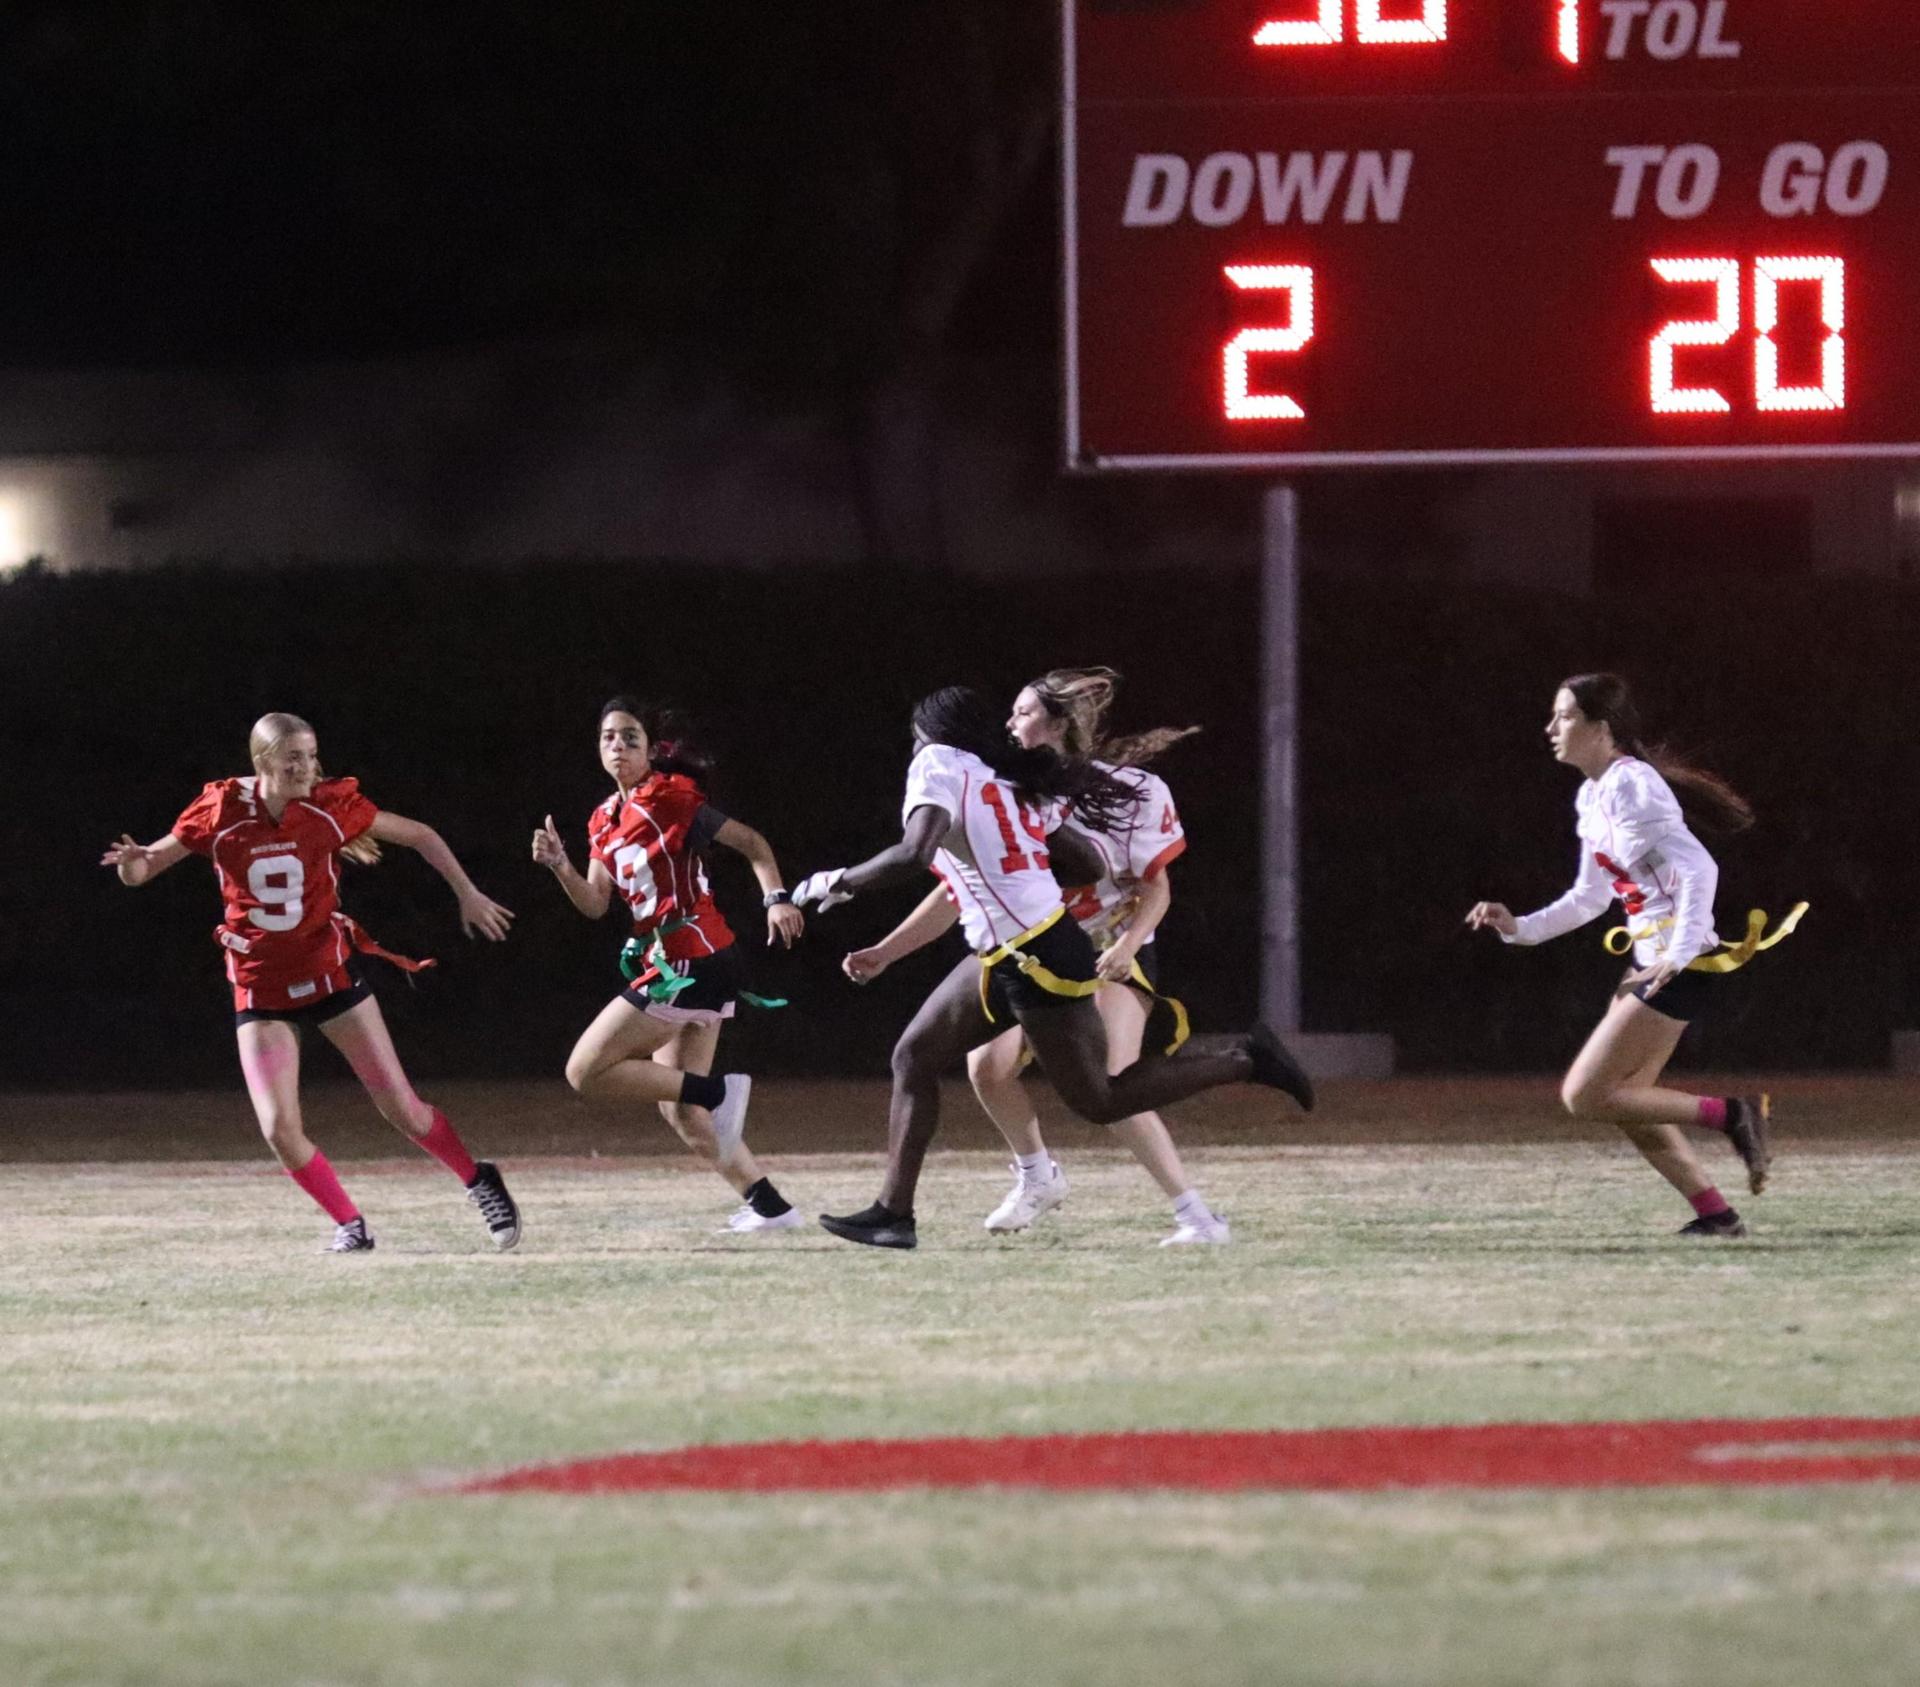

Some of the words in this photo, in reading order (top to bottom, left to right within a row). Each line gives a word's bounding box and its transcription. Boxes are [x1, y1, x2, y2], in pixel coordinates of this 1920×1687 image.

[1603, 0, 1742, 60] TOL
[1122, 149, 1414, 228] DOWN
[1605, 144, 1721, 220] TO
[1759, 140, 1890, 218] GO
[1223, 264, 1315, 420] 2
[1649, 255, 1846, 413] 20
[247, 854, 305, 932] 9
